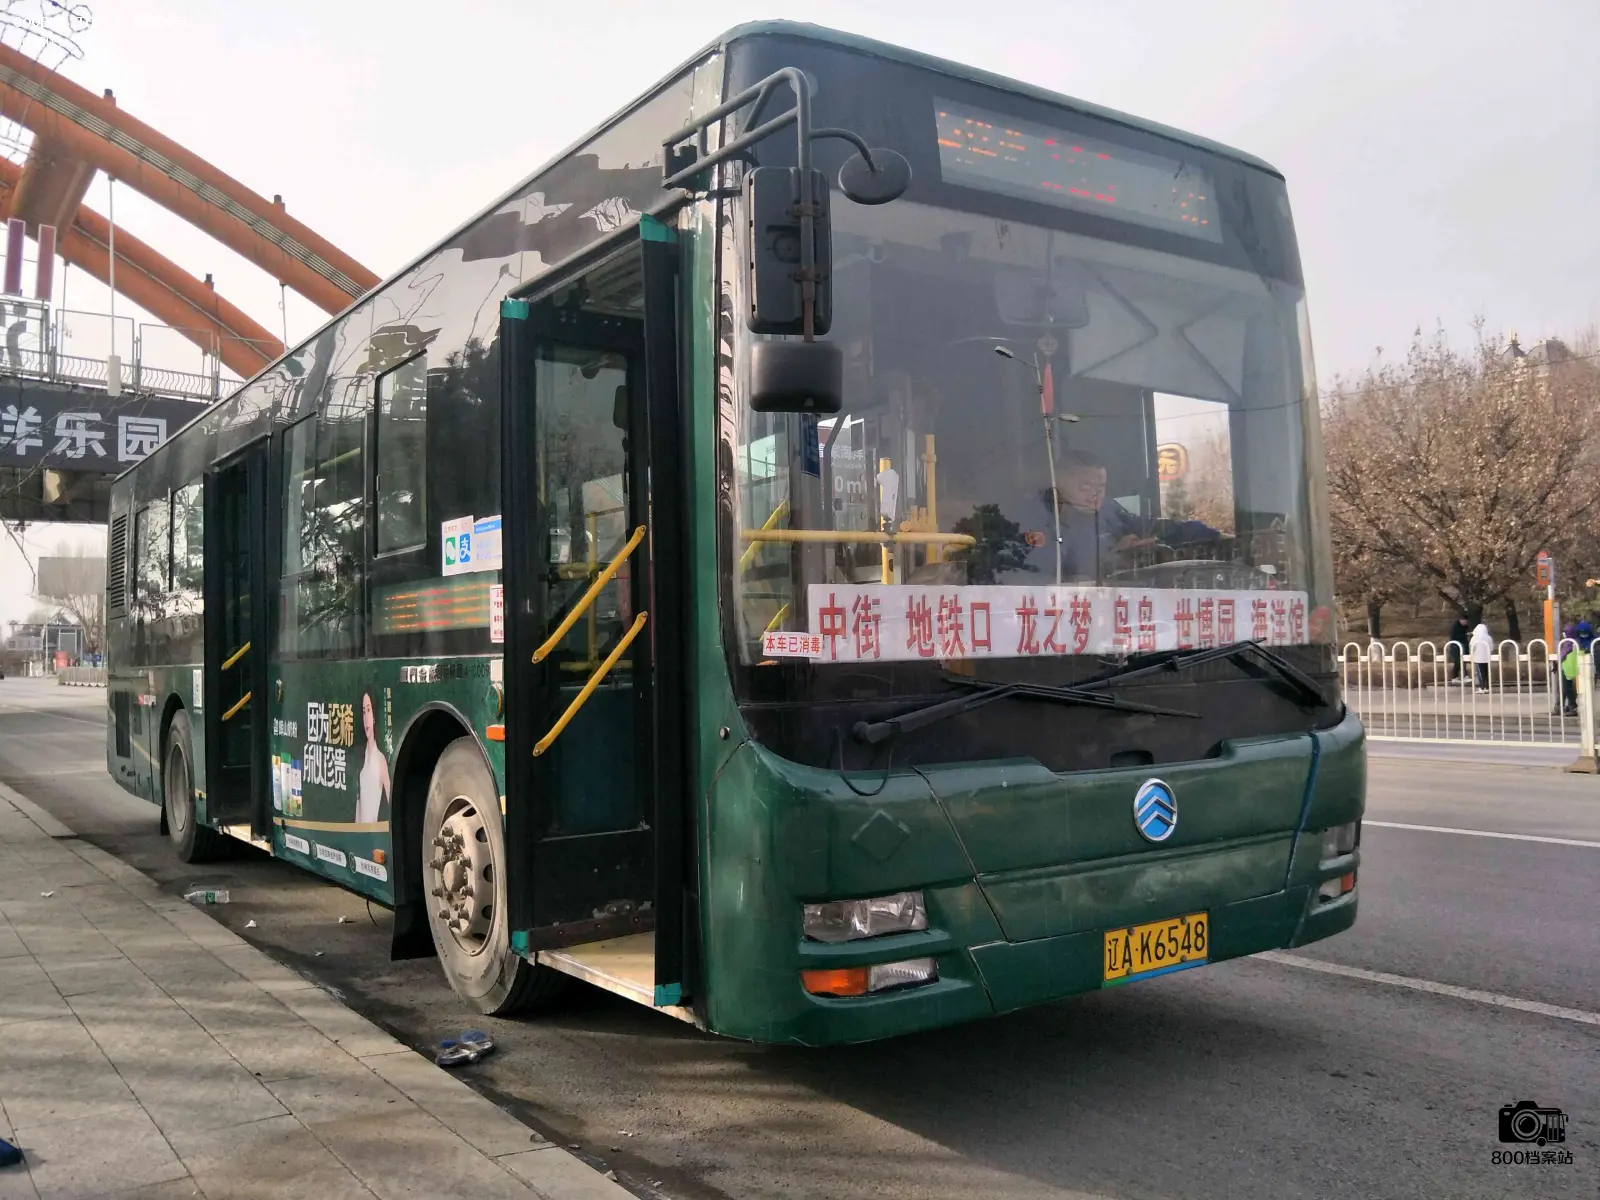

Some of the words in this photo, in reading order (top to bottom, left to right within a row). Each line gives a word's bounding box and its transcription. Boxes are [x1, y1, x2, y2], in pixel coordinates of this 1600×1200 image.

[765, 635, 821, 655] 本车已消毒
[819, 592, 881, 661] 中街
[905, 593, 992, 658] 地铁口
[1015, 594, 1092, 655] 龙之梦
[1112, 595, 1156, 652] 鸟岛
[1173, 597, 1235, 650] 世博园
[1250, 597, 1305, 646] 海洋馆
[307, 701, 354, 748] 因为珍稀
[302, 743, 347, 791] 所以珍贵
[1107, 920, 1206, 972] 辽A·K6548
